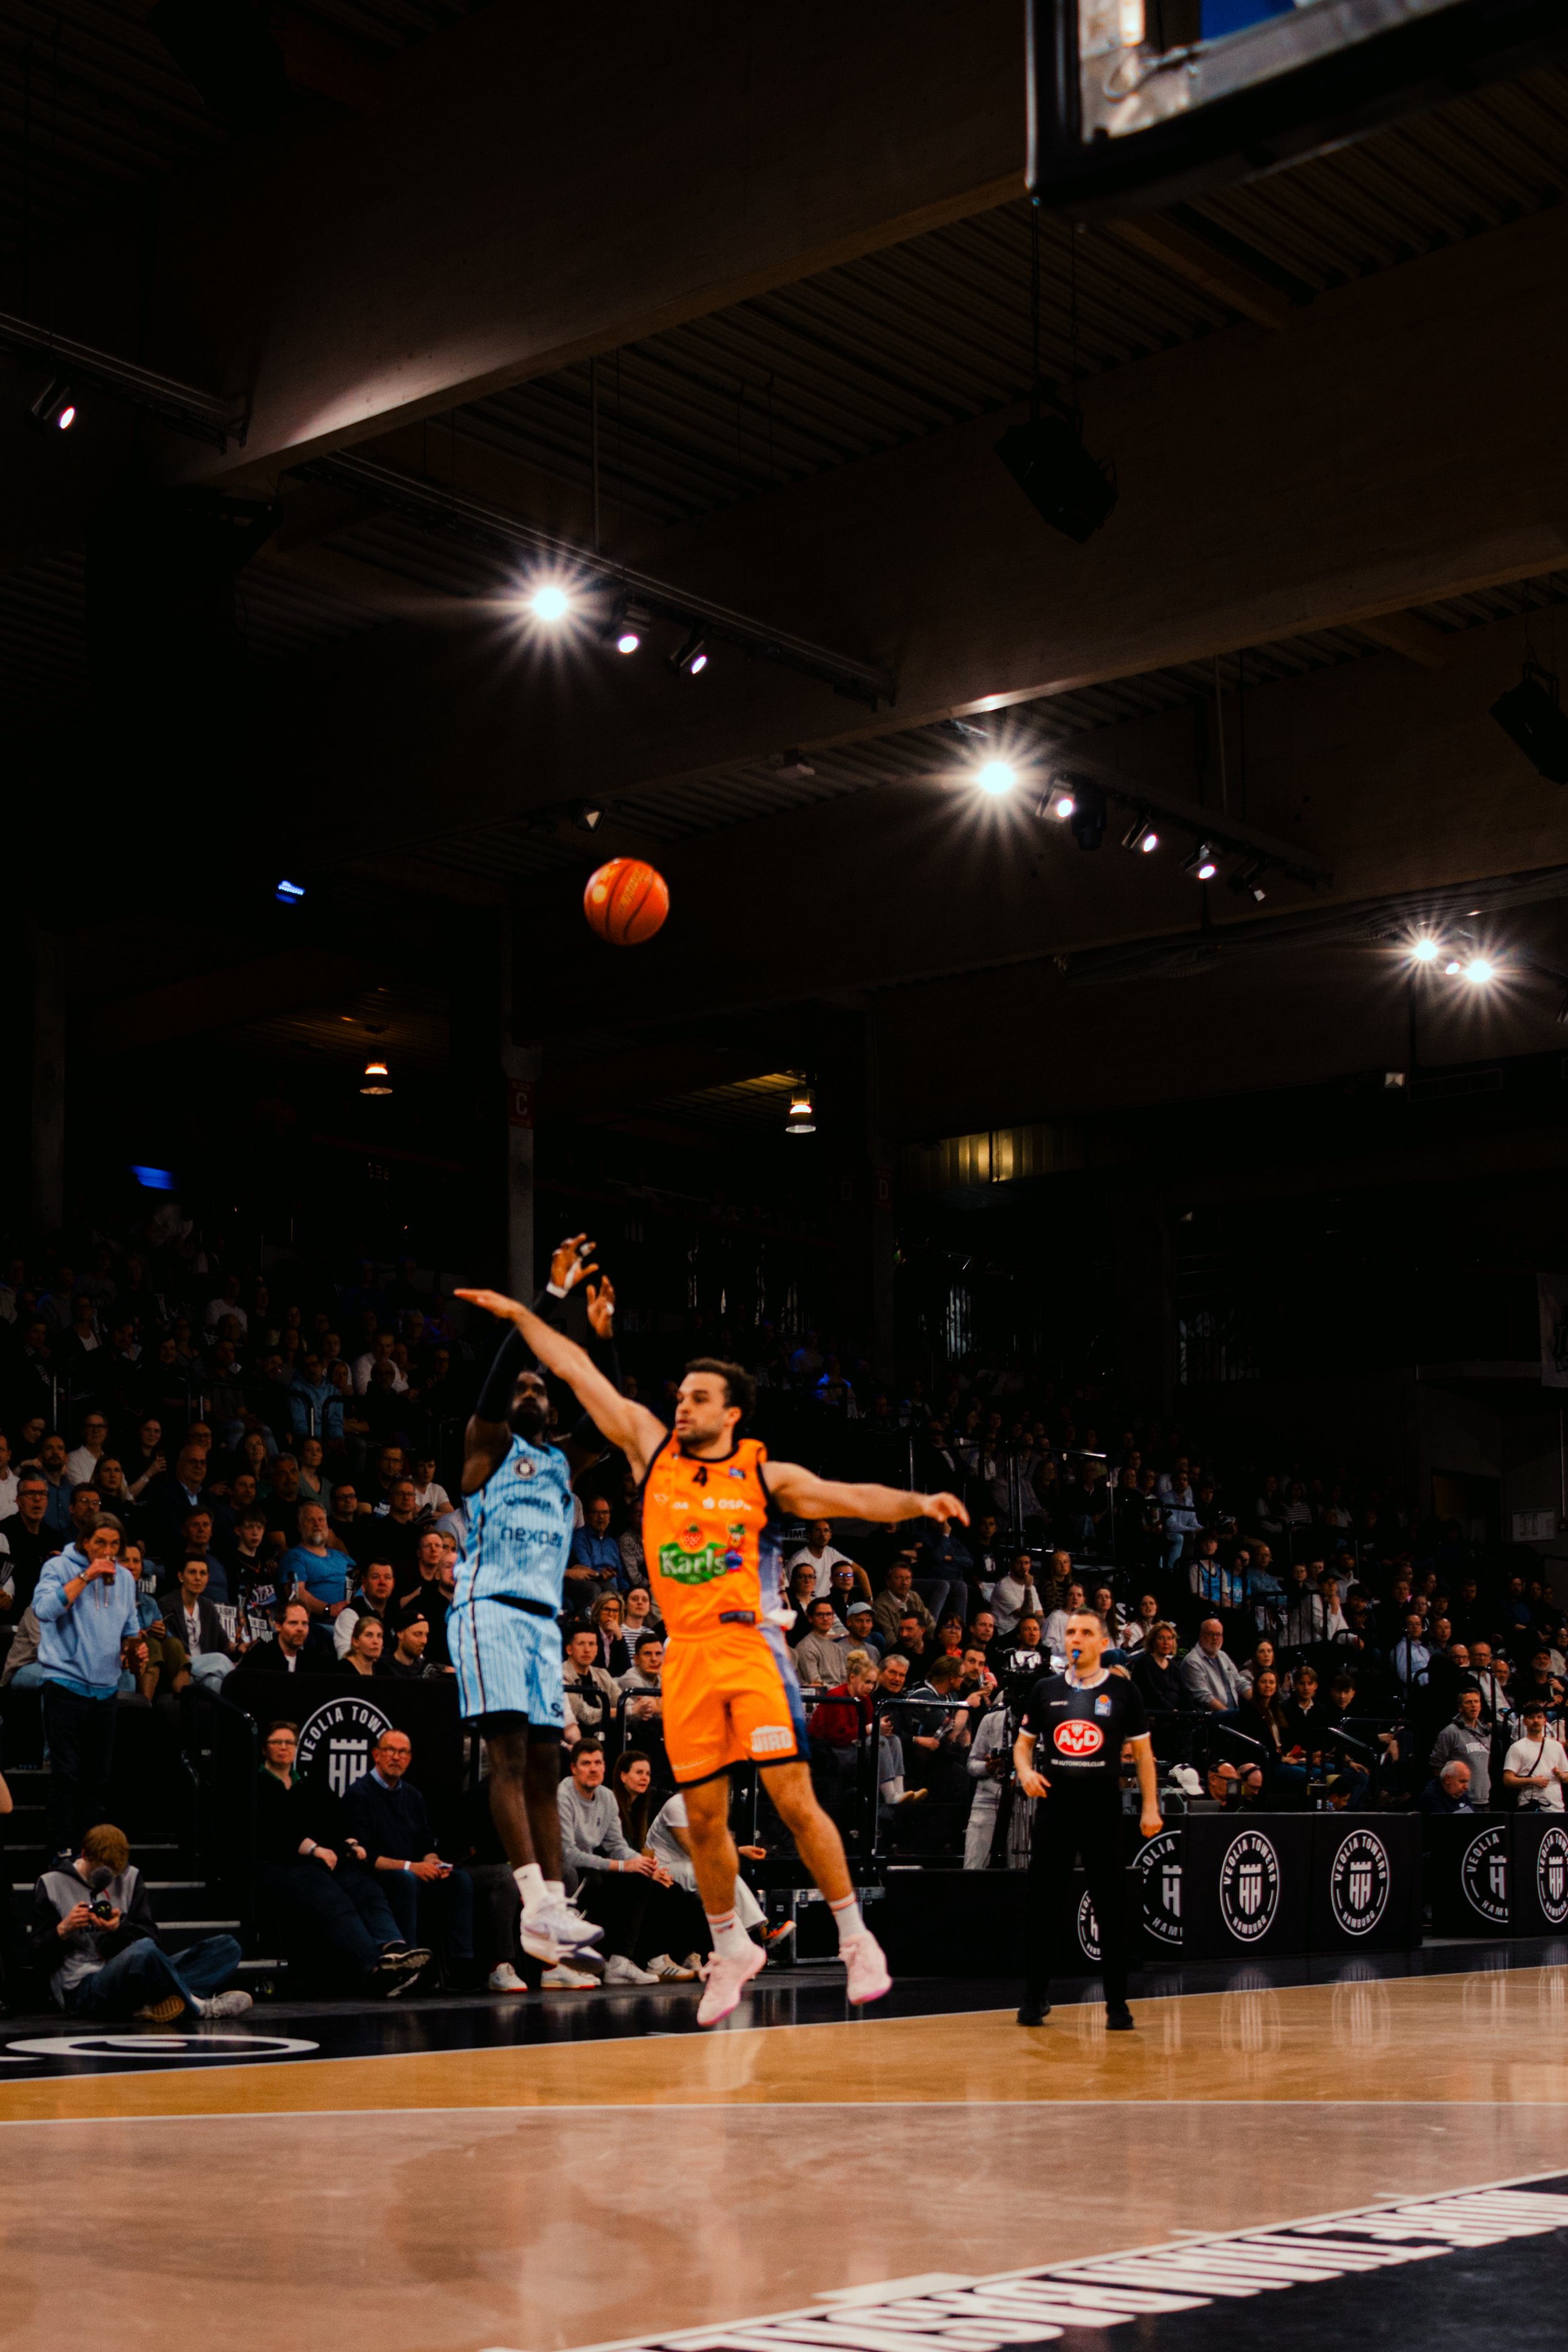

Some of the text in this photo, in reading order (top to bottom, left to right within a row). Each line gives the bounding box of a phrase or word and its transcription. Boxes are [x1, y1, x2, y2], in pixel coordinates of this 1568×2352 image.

[516, 1091, 528, 1116] C
[692, 1466, 707, 1487] 4
[662, 1549, 726, 1574] Karls
[300, 1705, 387, 1761] VEOLIA TOW
[1223, 1836, 1277, 1885] VEOLIA TOWERS
[1334, 1835, 1387, 1882] VEOLIA TOWERS
[1466, 1833, 1500, 1873] VEOLIA
[1342, 1909, 1376, 1929] HAMBURG
[1481, 1900, 1508, 1917] HAM
[1152, 1917, 1184, 1937] HAM
[1232, 1914, 1268, 1935] HAMBURG
[1046, 2233, 1454, 2298] THAN
